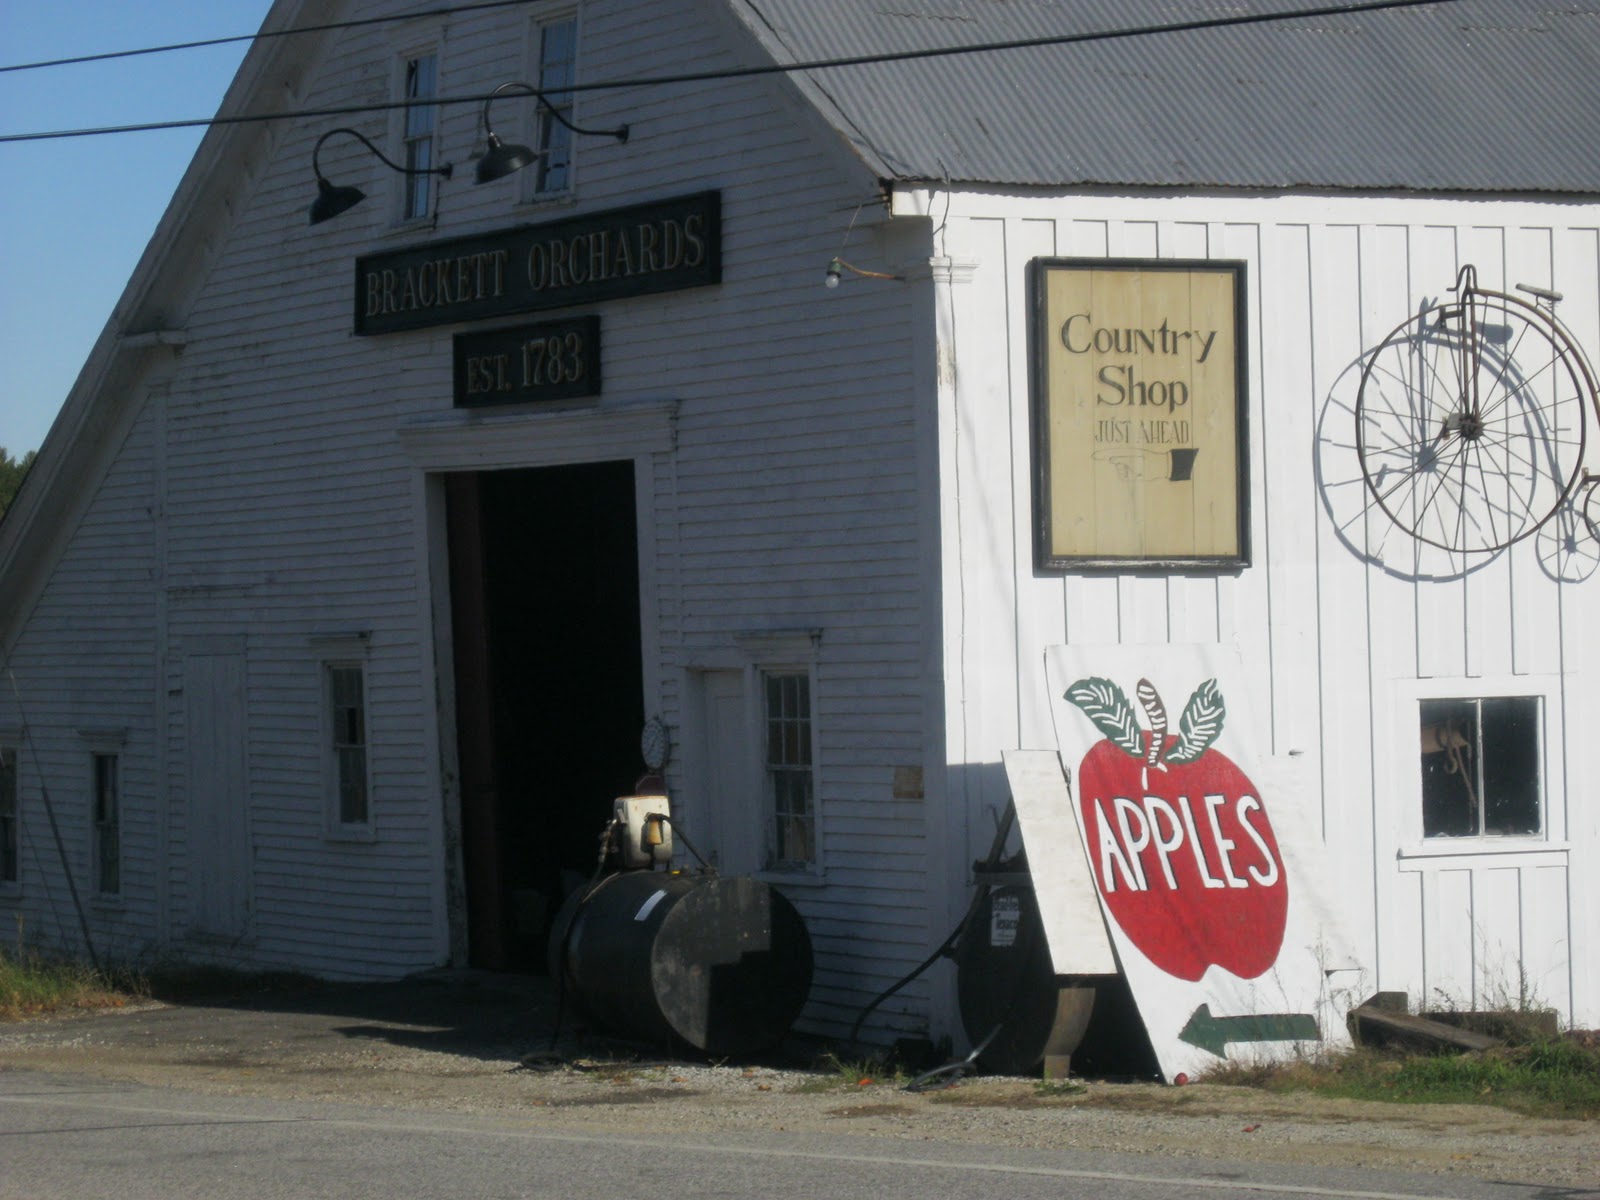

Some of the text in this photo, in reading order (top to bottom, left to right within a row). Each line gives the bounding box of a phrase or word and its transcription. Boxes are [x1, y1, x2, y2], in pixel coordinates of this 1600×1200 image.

[366, 214, 704, 317] BRACKETT ORCHARDS
[467, 332, 583, 393] EST. 1783
[1097, 365, 1188, 414] Shop
[1095, 420, 1188, 443] JUST AHEAD
[1095, 795, 1279, 891] APPLES
